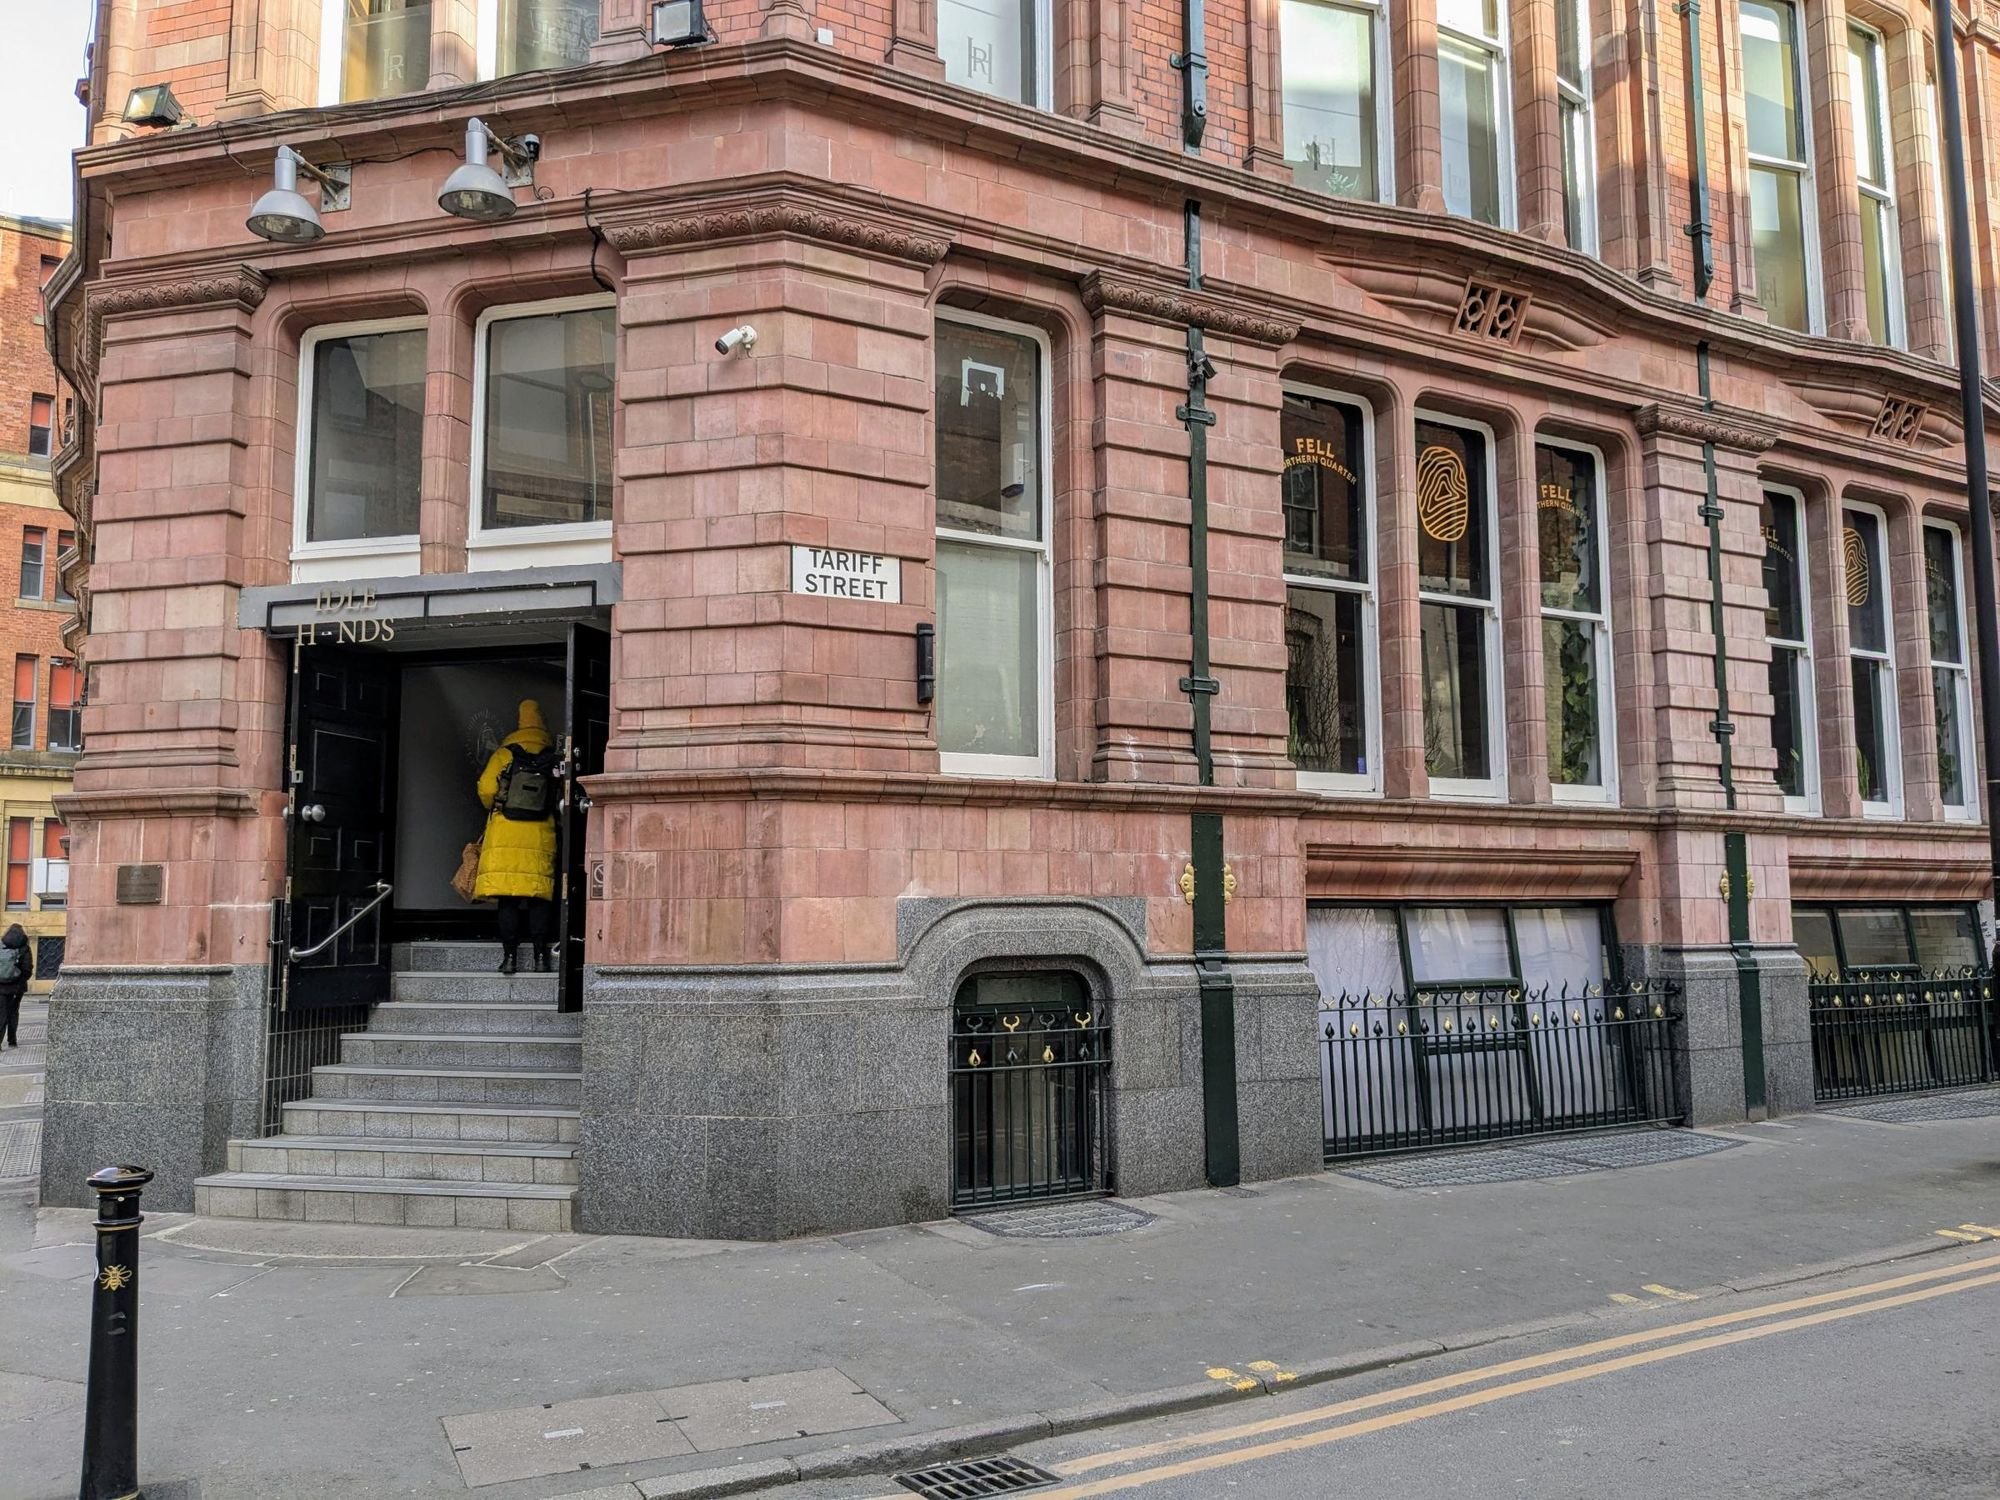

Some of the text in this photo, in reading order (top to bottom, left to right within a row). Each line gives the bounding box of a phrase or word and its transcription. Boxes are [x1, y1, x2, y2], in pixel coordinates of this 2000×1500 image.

[1295, 438, 1335, 459] FELL
[1282, 455, 1357, 486] ORTHERN QUARTER
[1536, 499, 1559, 510] THERN
[1541, 484, 1573, 503] FELL
[1760, 526, 1779, 543] ELL
[808, 548, 884, 575] TARIFF
[314, 585, 378, 612] IDLE
[804, 573, 888, 600] STREET
[295, 617, 396, 647] HNDS
